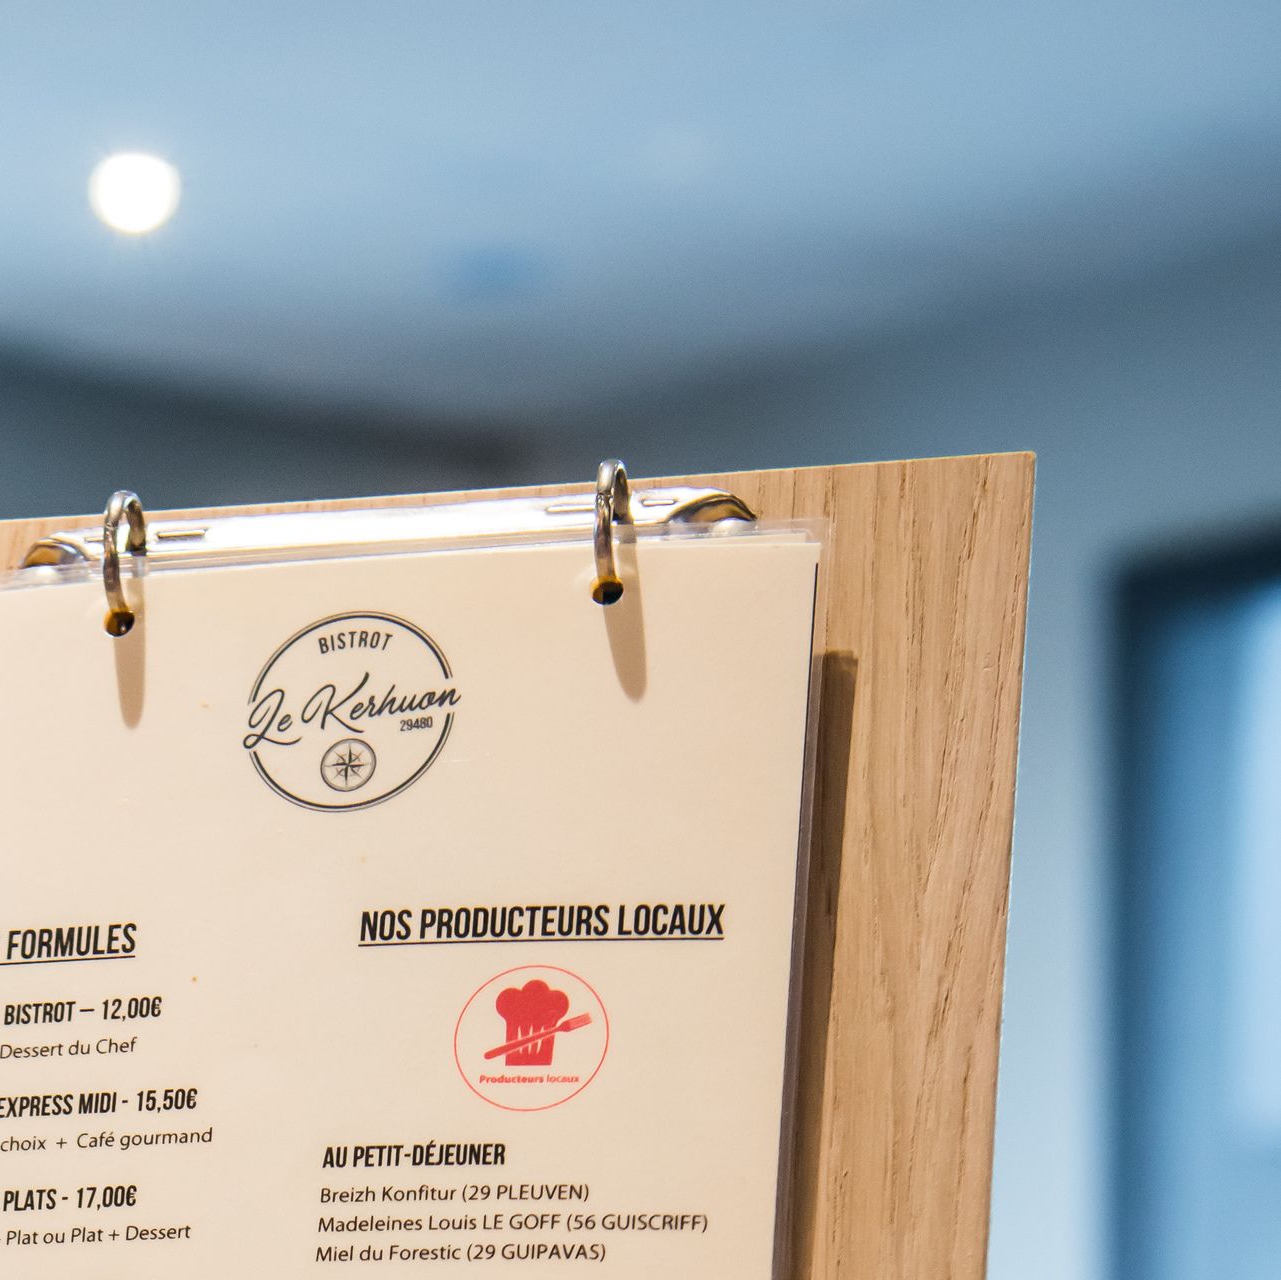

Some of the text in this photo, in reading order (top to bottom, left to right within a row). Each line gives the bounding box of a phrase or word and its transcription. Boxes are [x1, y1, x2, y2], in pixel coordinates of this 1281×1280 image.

[318, 631, 393, 654] BISTROT
[400, 717, 433, 732] 29480
[359, 904, 725, 941] NOS PRODUCTEURS LOCAUX
[6, 923, 137, 960] FORMULES
[4, 1001, 76, 1026] BISTROT
[102, 996, 162, 1022] 12,00€
[0, 1042, 63, 1060] Dessert
[68, 1039, 91, 1055] du
[95, 1036, 138, 1054] Chef
[479, 1074, 579, 1084] Producteurs locaux
[78, 1092, 117, 1115] MIDI
[136, 1088, 198, 1114] 15,50€
[0, 1135, 46, 1152] choix
[76, 1131, 115, 1150] Café
[120, 1127, 213, 1150] gourmand
[322, 1139, 506, 1168] AU PETIT-DÉJEUNER
[3, 1188, 57, 1212] PLATS
[76, 1185, 137, 1211] 17,00€
[320, 1183, 589, 1204] Breizh Konfitur (29 PLEUVEN)
[6, 1229, 38, 1246] Plat
[43, 1232, 65, 1244] ou
[70, 1227, 103, 1243] Plat
[125, 1224, 191, 1241] Dessert
[317, 1213, 709, 1233] Madeleines Louis LE GOFF (56 GUISCRIFF)
[315, 1242, 606, 1263] Miel du Forestic (29 GUIPAVAS)
